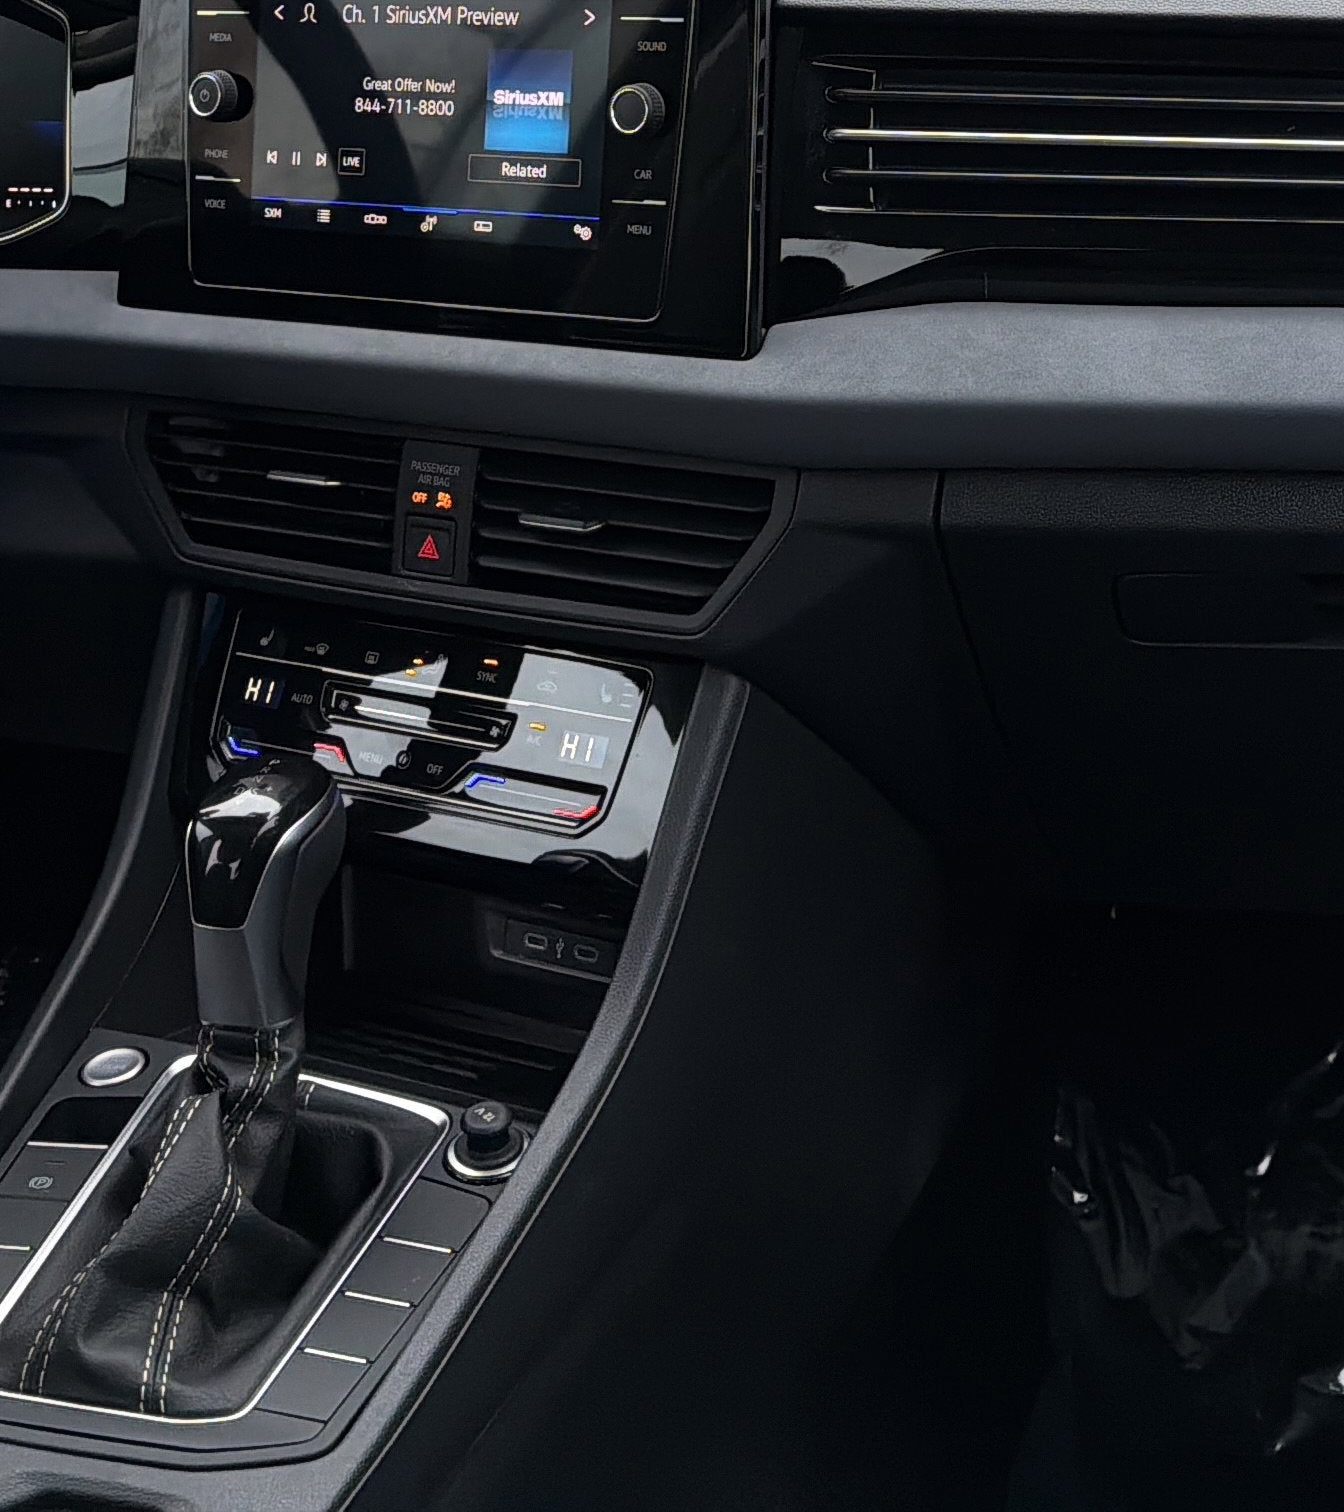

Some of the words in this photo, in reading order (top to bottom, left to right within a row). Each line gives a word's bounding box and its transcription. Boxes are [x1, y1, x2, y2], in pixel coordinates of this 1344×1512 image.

[342, 3, 366, 24] Ch.
[372, 4, 379, 23] 1
[385, 4, 452, 25] SiriusXM
[456, 5, 520, 26] Preview
[209, 33, 233, 43] MEDIA
[637, 40, 667, 52] SOUND
[363, 76, 392, 92] Great
[394, 77, 423, 93] Offer
[425, 78, 456, 94] Now!
[493, 88, 565, 106] SiriusXM
[354, 97, 455, 117] 844-711-8800
[205, 148, 229, 159] PHONE
[342, 156, 361, 168] LIVE
[501, 161, 547, 179] Related
[633, 168, 653, 180] CAR
[204, 199, 227, 210] VOICE
[264, 207, 283, 219] SXM
[626, 224, 653, 236] MENU
[411, 460, 461, 477] PASSENGER
[417, 473, 433, 485] AIR
[433, 475, 451, 488] BAG
[411, 490, 428, 504] OFF
[476, 670, 497, 684] SYNC
[243, 676, 276, 705] HI
[290, 691, 314, 705] AUTO
[560, 732, 596, 764] HI
[358, 750, 384, 765] MENU
[426, 763, 444, 776] OFF
